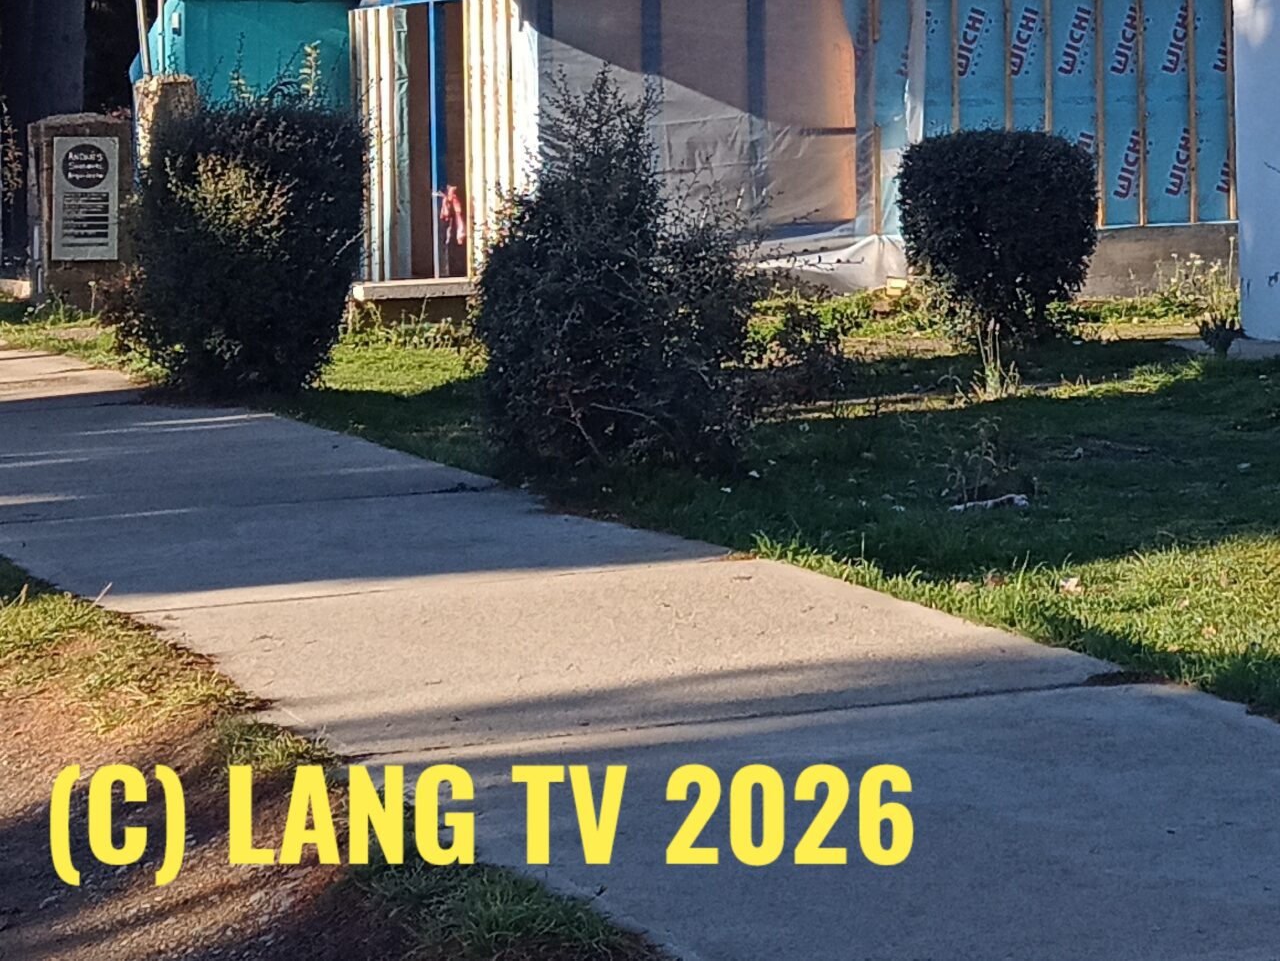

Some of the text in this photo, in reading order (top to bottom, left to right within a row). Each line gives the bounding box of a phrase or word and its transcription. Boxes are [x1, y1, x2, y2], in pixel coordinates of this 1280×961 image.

[957, 6, 986, 77] WICHI
[1011, 6, 1039, 76] WICHI
[1058, 6, 1092, 75] WICHI
